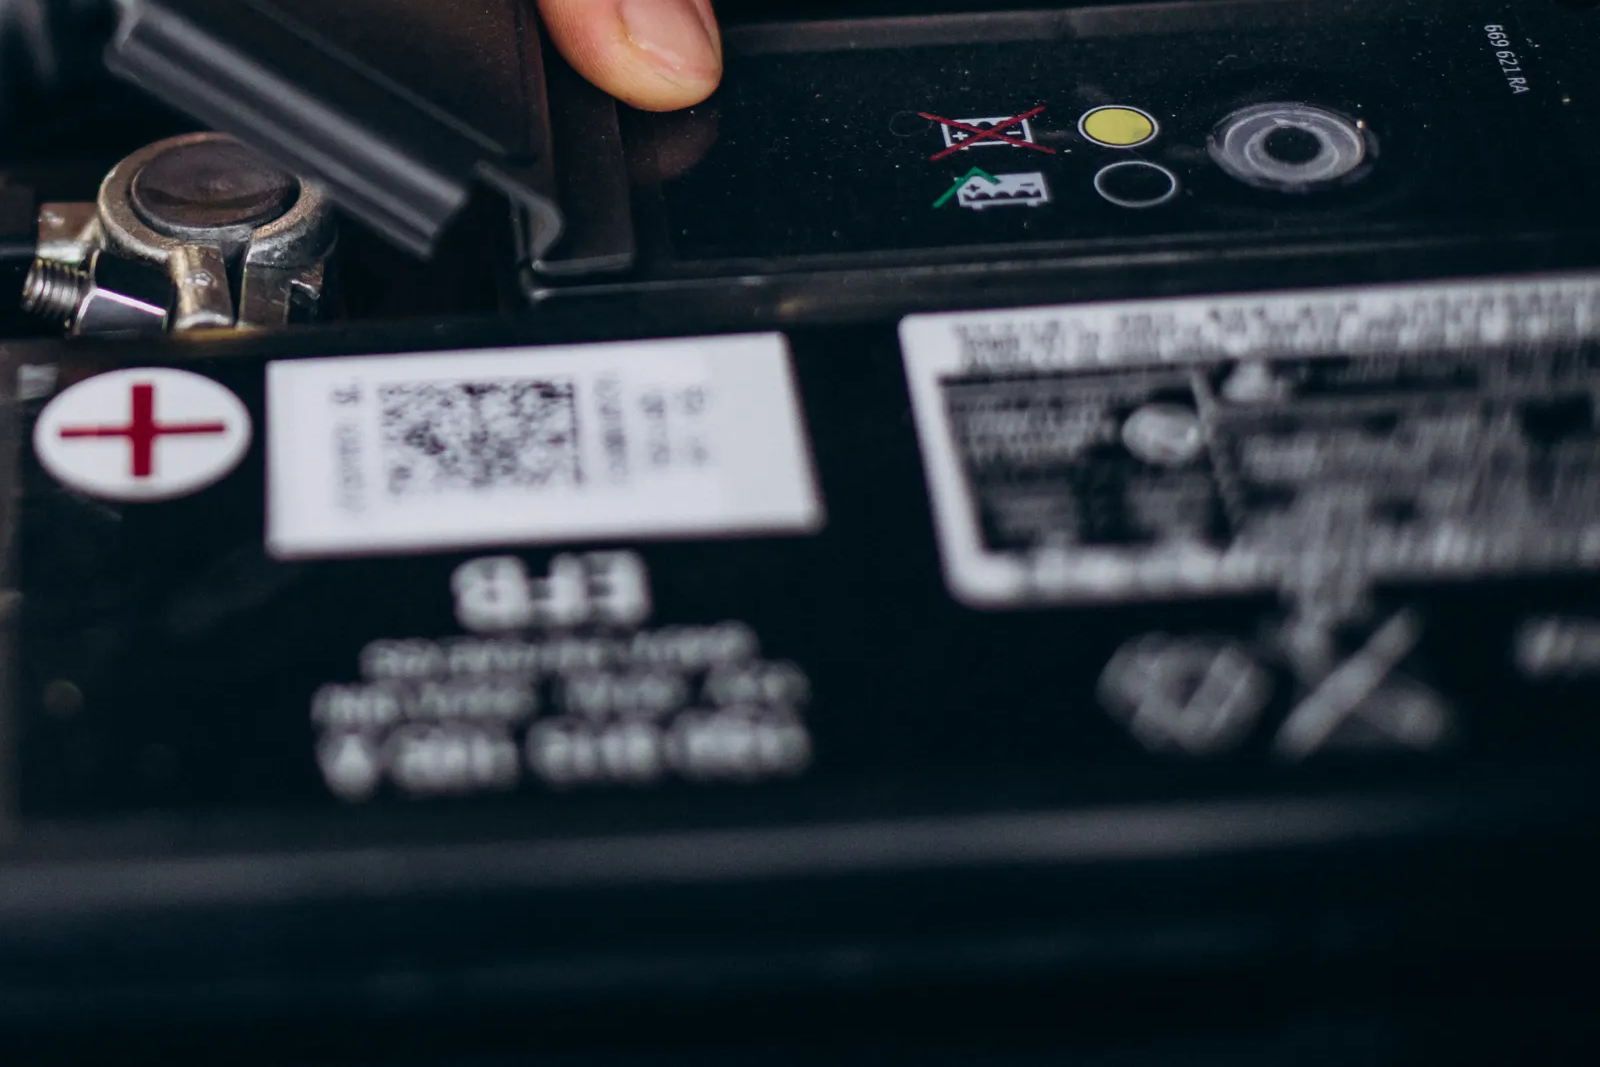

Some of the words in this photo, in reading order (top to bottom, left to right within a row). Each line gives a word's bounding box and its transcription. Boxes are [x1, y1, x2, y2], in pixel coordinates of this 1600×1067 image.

[1484, 24, 1510, 47] 669
[1495, 50, 1522, 74] 621
[1506, 77, 1531, 95] RA
[452, 550, 650, 631] EFB
